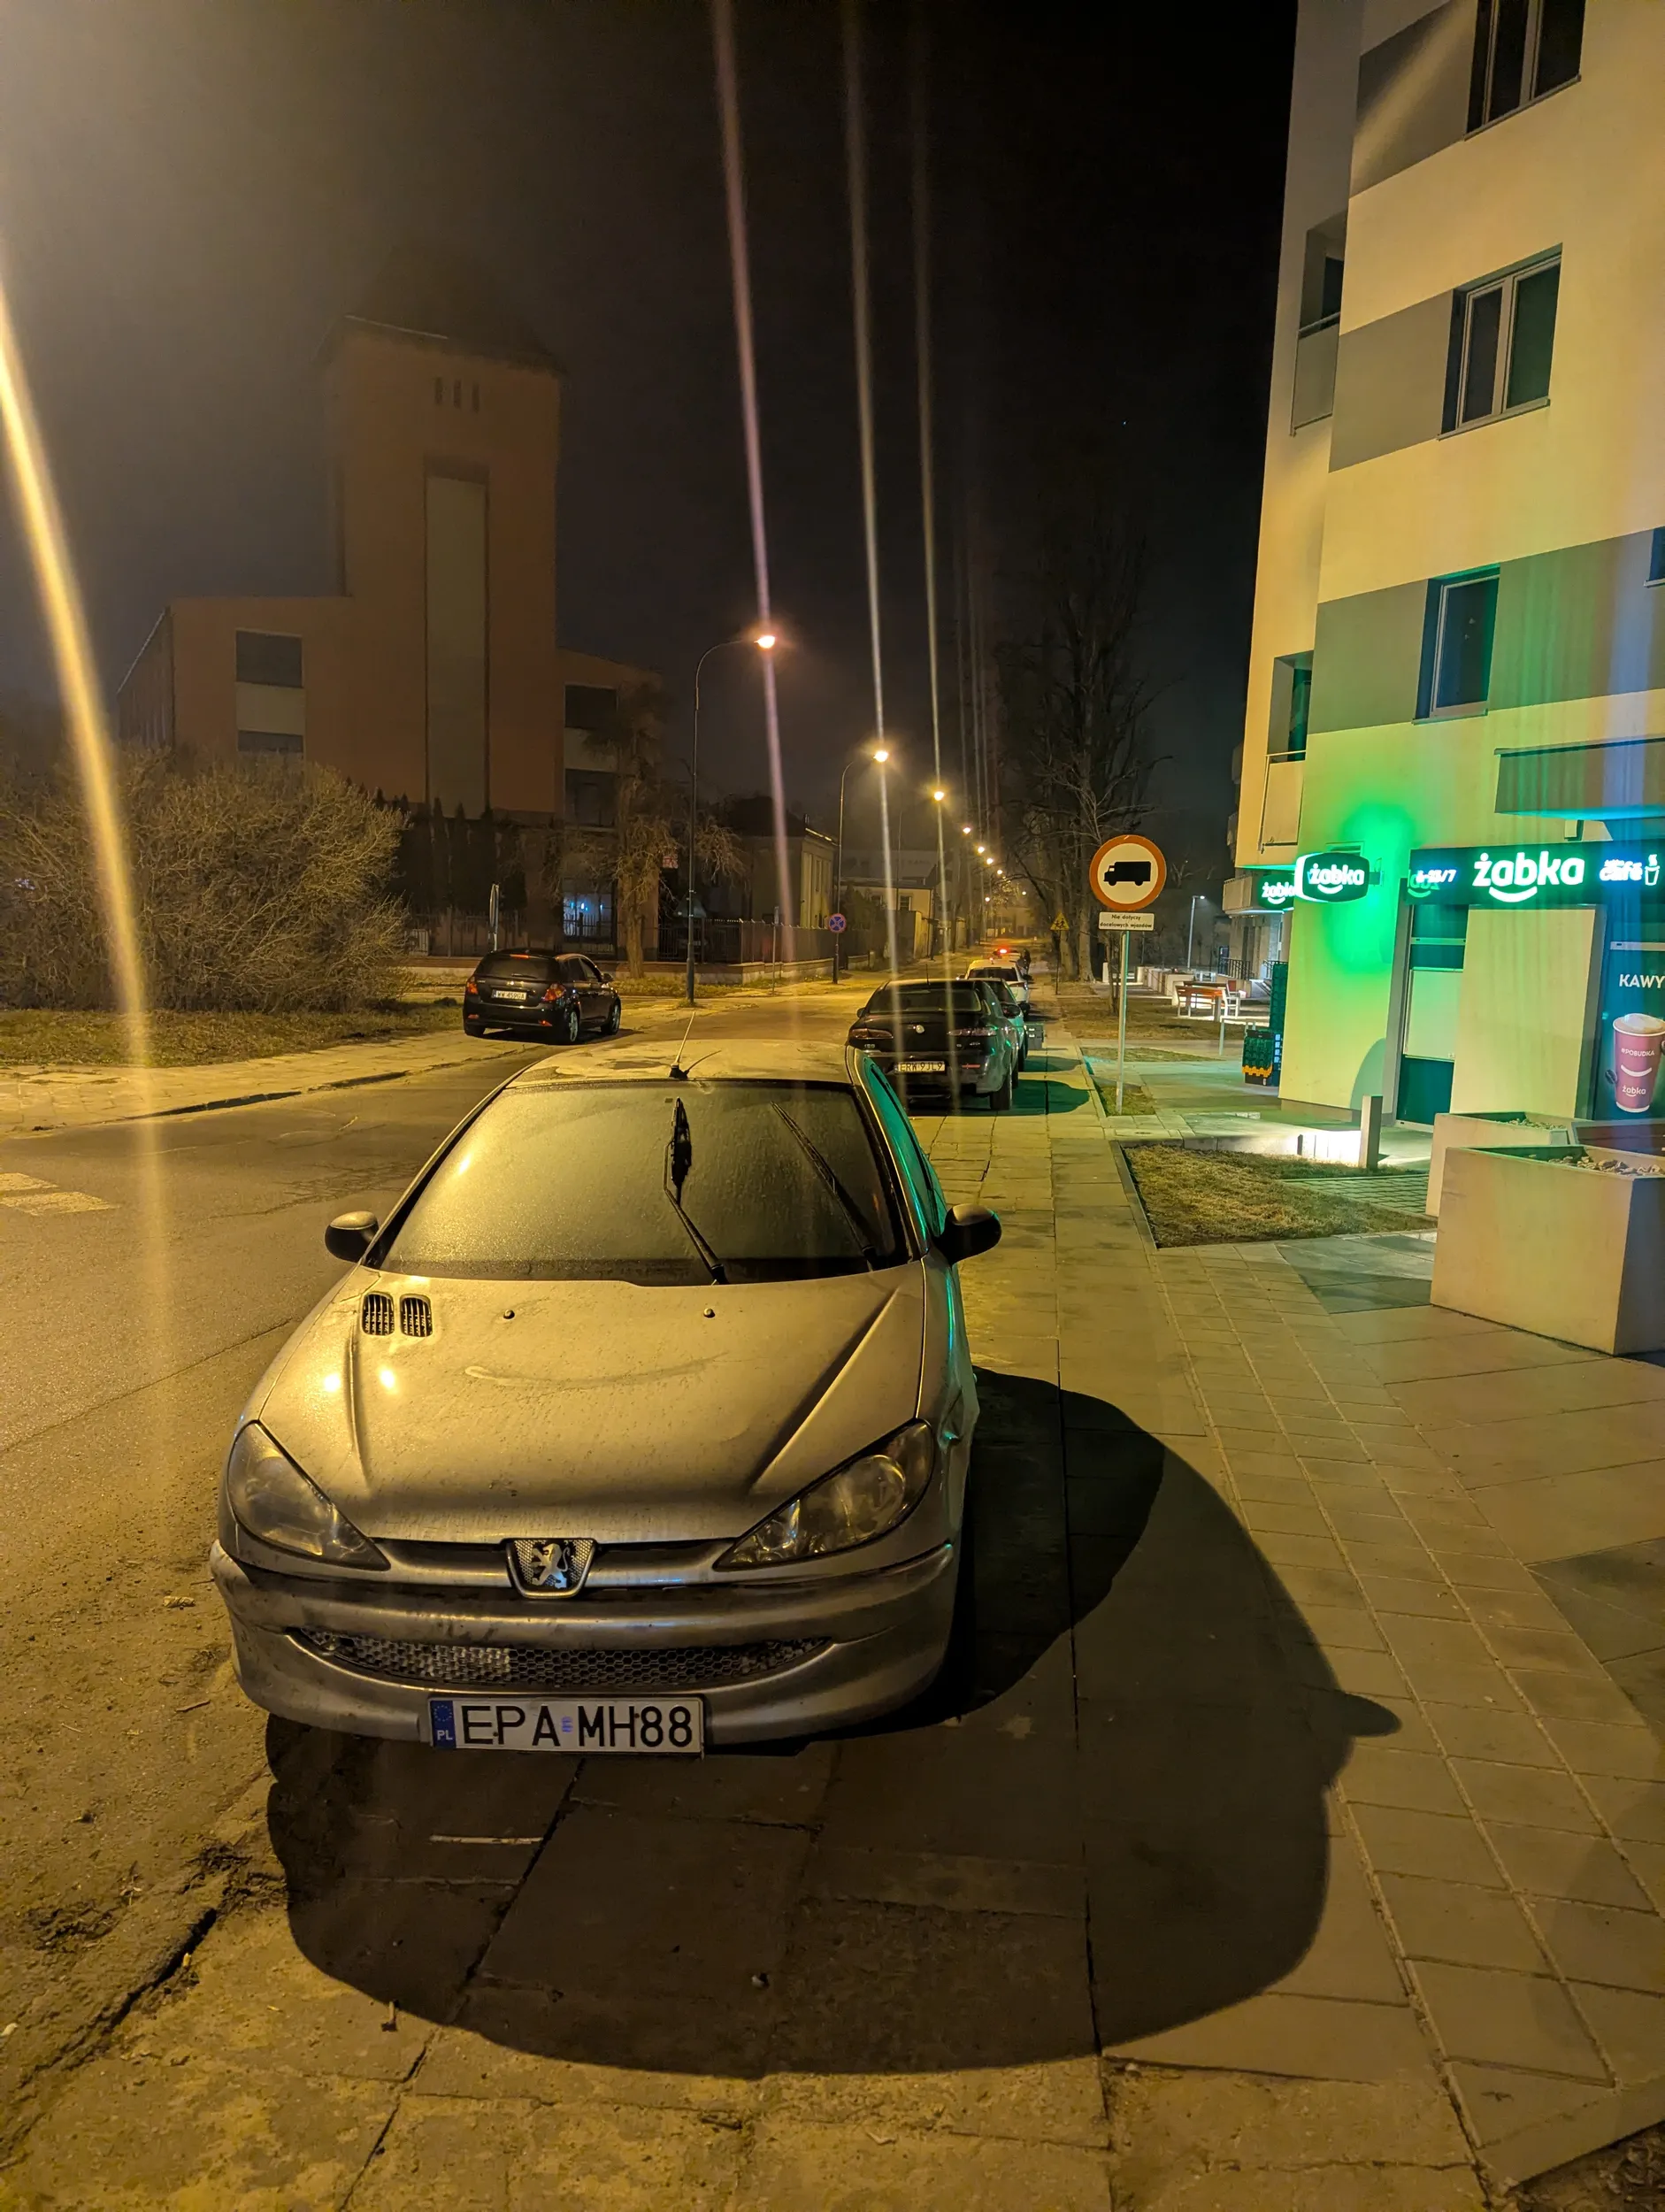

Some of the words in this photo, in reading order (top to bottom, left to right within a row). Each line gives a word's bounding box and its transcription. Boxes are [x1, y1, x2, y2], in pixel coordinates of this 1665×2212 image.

[1308, 863, 1365, 886] żabka
[1472, 850, 1585, 887] żabka
[1618, 973, 1665, 989] KAWY
[900, 1063, 917, 1071] ERW
[920, 1063, 942, 1071] 9JL9
[1622, 1085, 1646, 1095] żabka
[461, 1705, 561, 1747] EPA
[578, 1705, 693, 1747] MH88
[436, 1730, 453, 1741] PL
